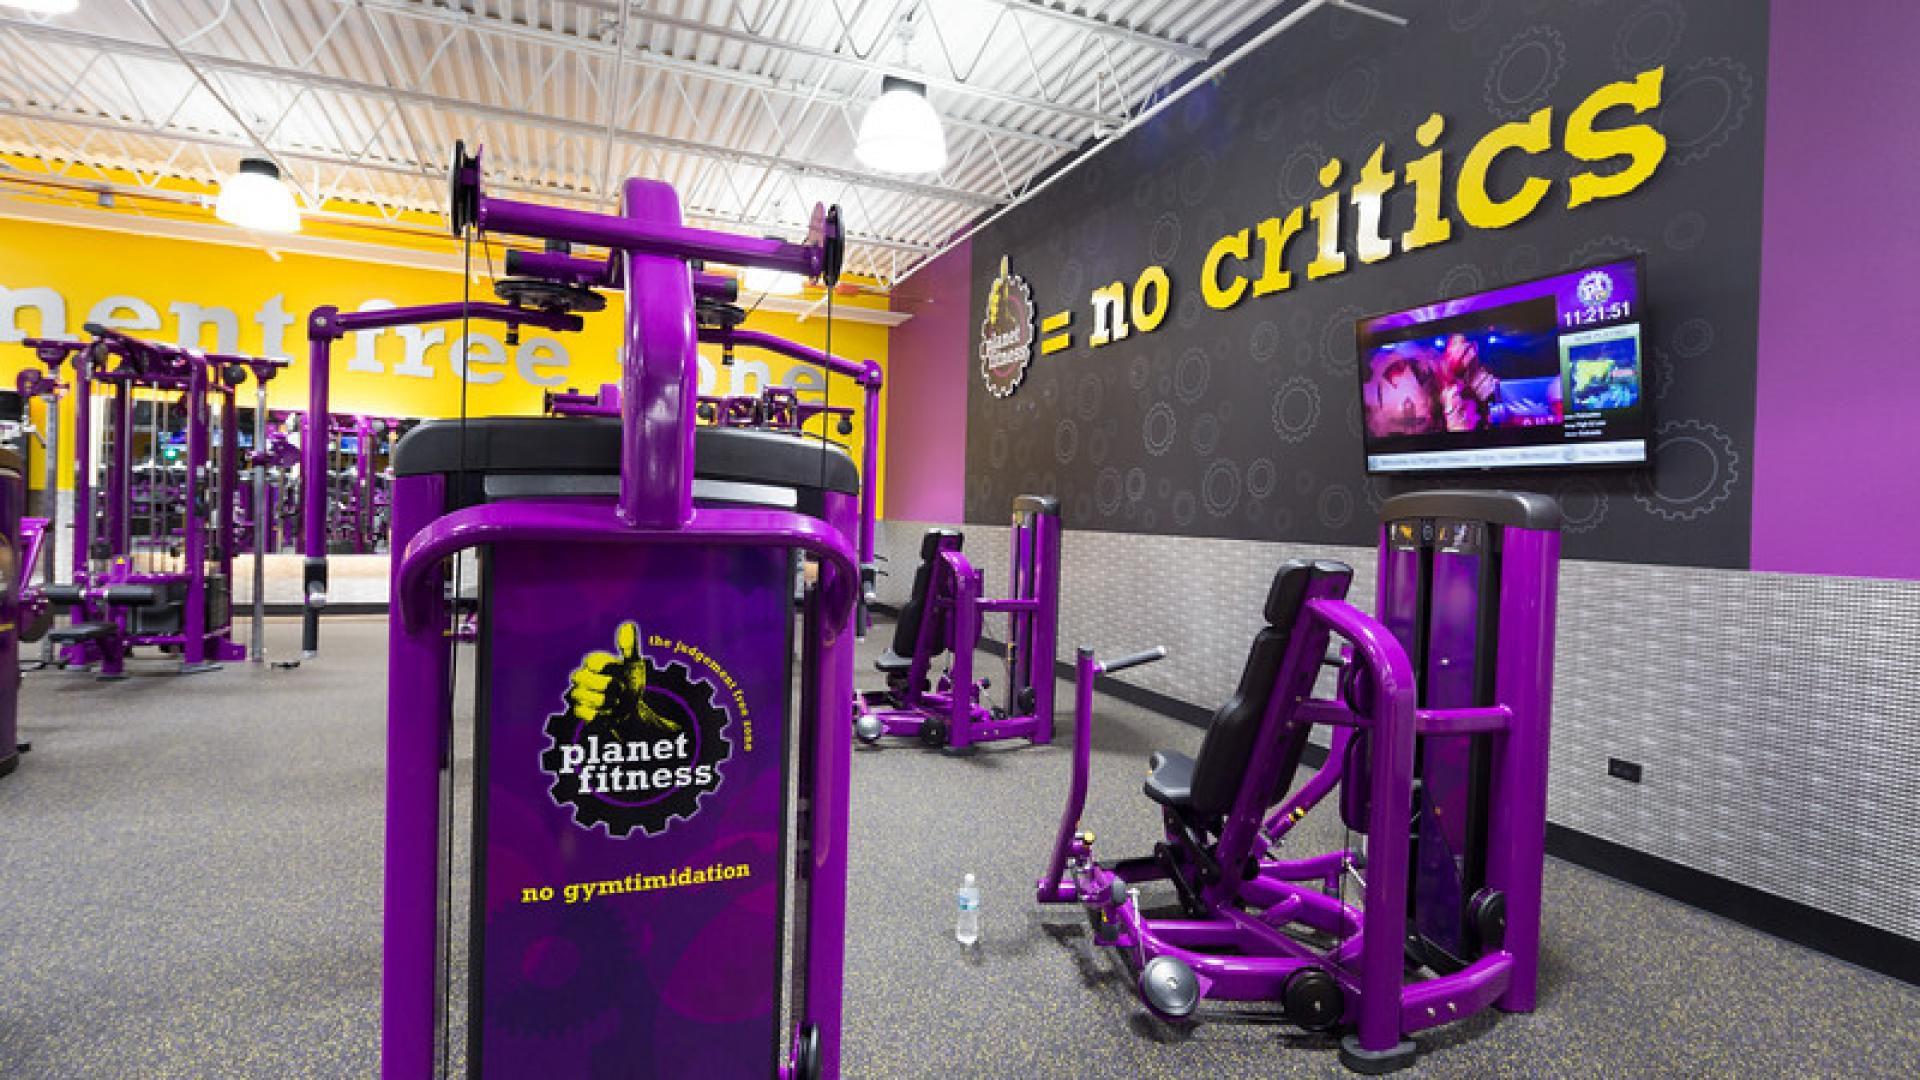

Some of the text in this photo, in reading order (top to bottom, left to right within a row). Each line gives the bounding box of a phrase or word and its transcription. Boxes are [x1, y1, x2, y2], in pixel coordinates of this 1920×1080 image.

[1090, 265, 1171, 347] no
[1201, 65, 1667, 309] critics
[1564, 300, 1630, 328] 11:21:51
[648, 635, 672, 649] the
[731, 688, 749, 718] free
[743, 719, 753, 752] zone
[559, 732, 688, 774] planet
[577, 764, 713, 794] fitness
[521, 863, 750, 904] no gymtimidation
